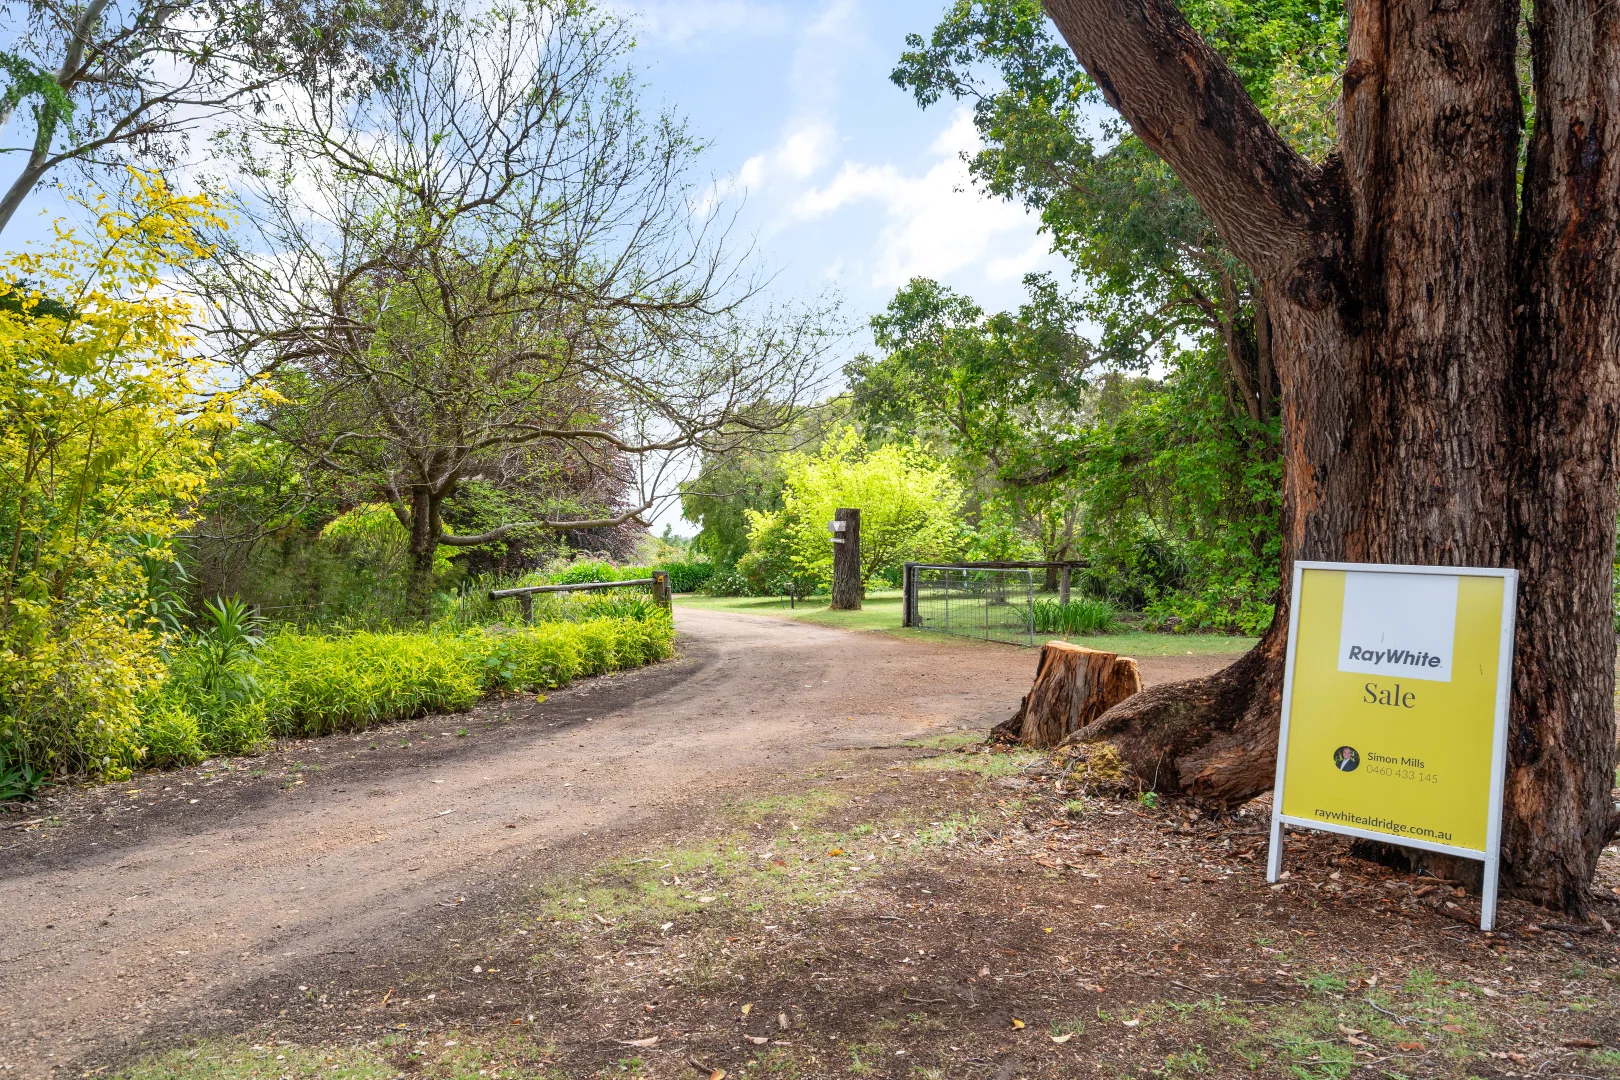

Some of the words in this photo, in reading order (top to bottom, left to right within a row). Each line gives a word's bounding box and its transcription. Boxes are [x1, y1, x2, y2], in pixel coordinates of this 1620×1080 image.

[1363, 682, 1416, 708] Sale
[1367, 752, 1398, 765] Simon
[1400, 757, 1425, 769] Mills
[1366, 764, 1393, 776] 0460
[1395, 769, 1415, 780] 433
[1419, 772, 1438, 784] 145
[1314, 808, 1452, 841] raywhitealdridge.com.au
